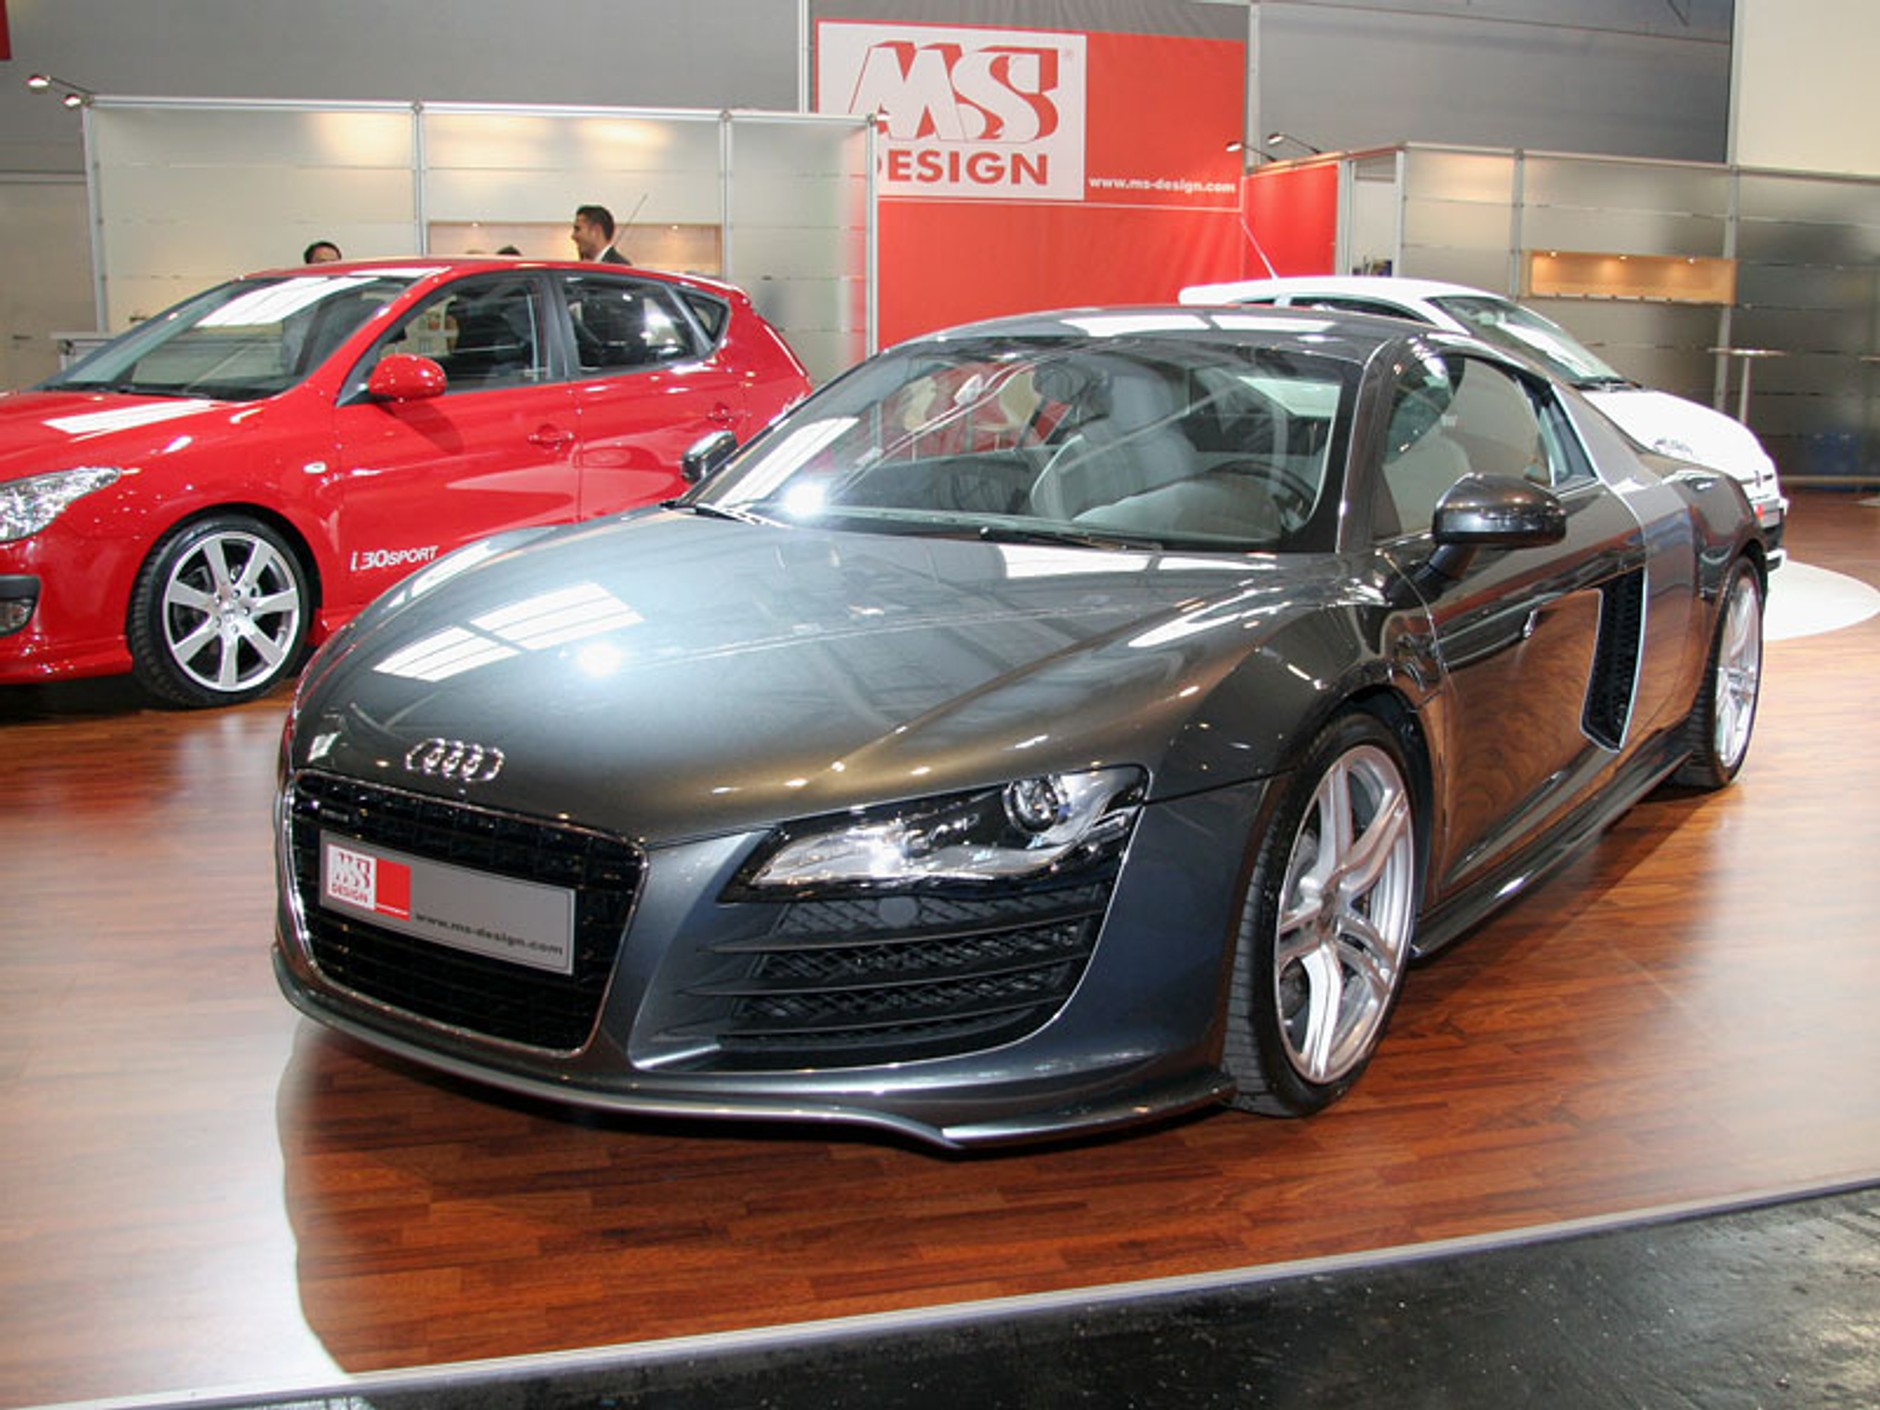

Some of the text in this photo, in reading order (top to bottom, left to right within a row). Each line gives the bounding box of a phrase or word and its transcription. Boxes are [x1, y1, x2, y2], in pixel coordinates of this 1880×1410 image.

[877, 149, 1048, 185] ESIGN
[1089, 177, 1236, 195] www.ms-design.com
[331, 883, 369, 905] DESIGN
[416, 912, 563, 956] www.ms-design.com
